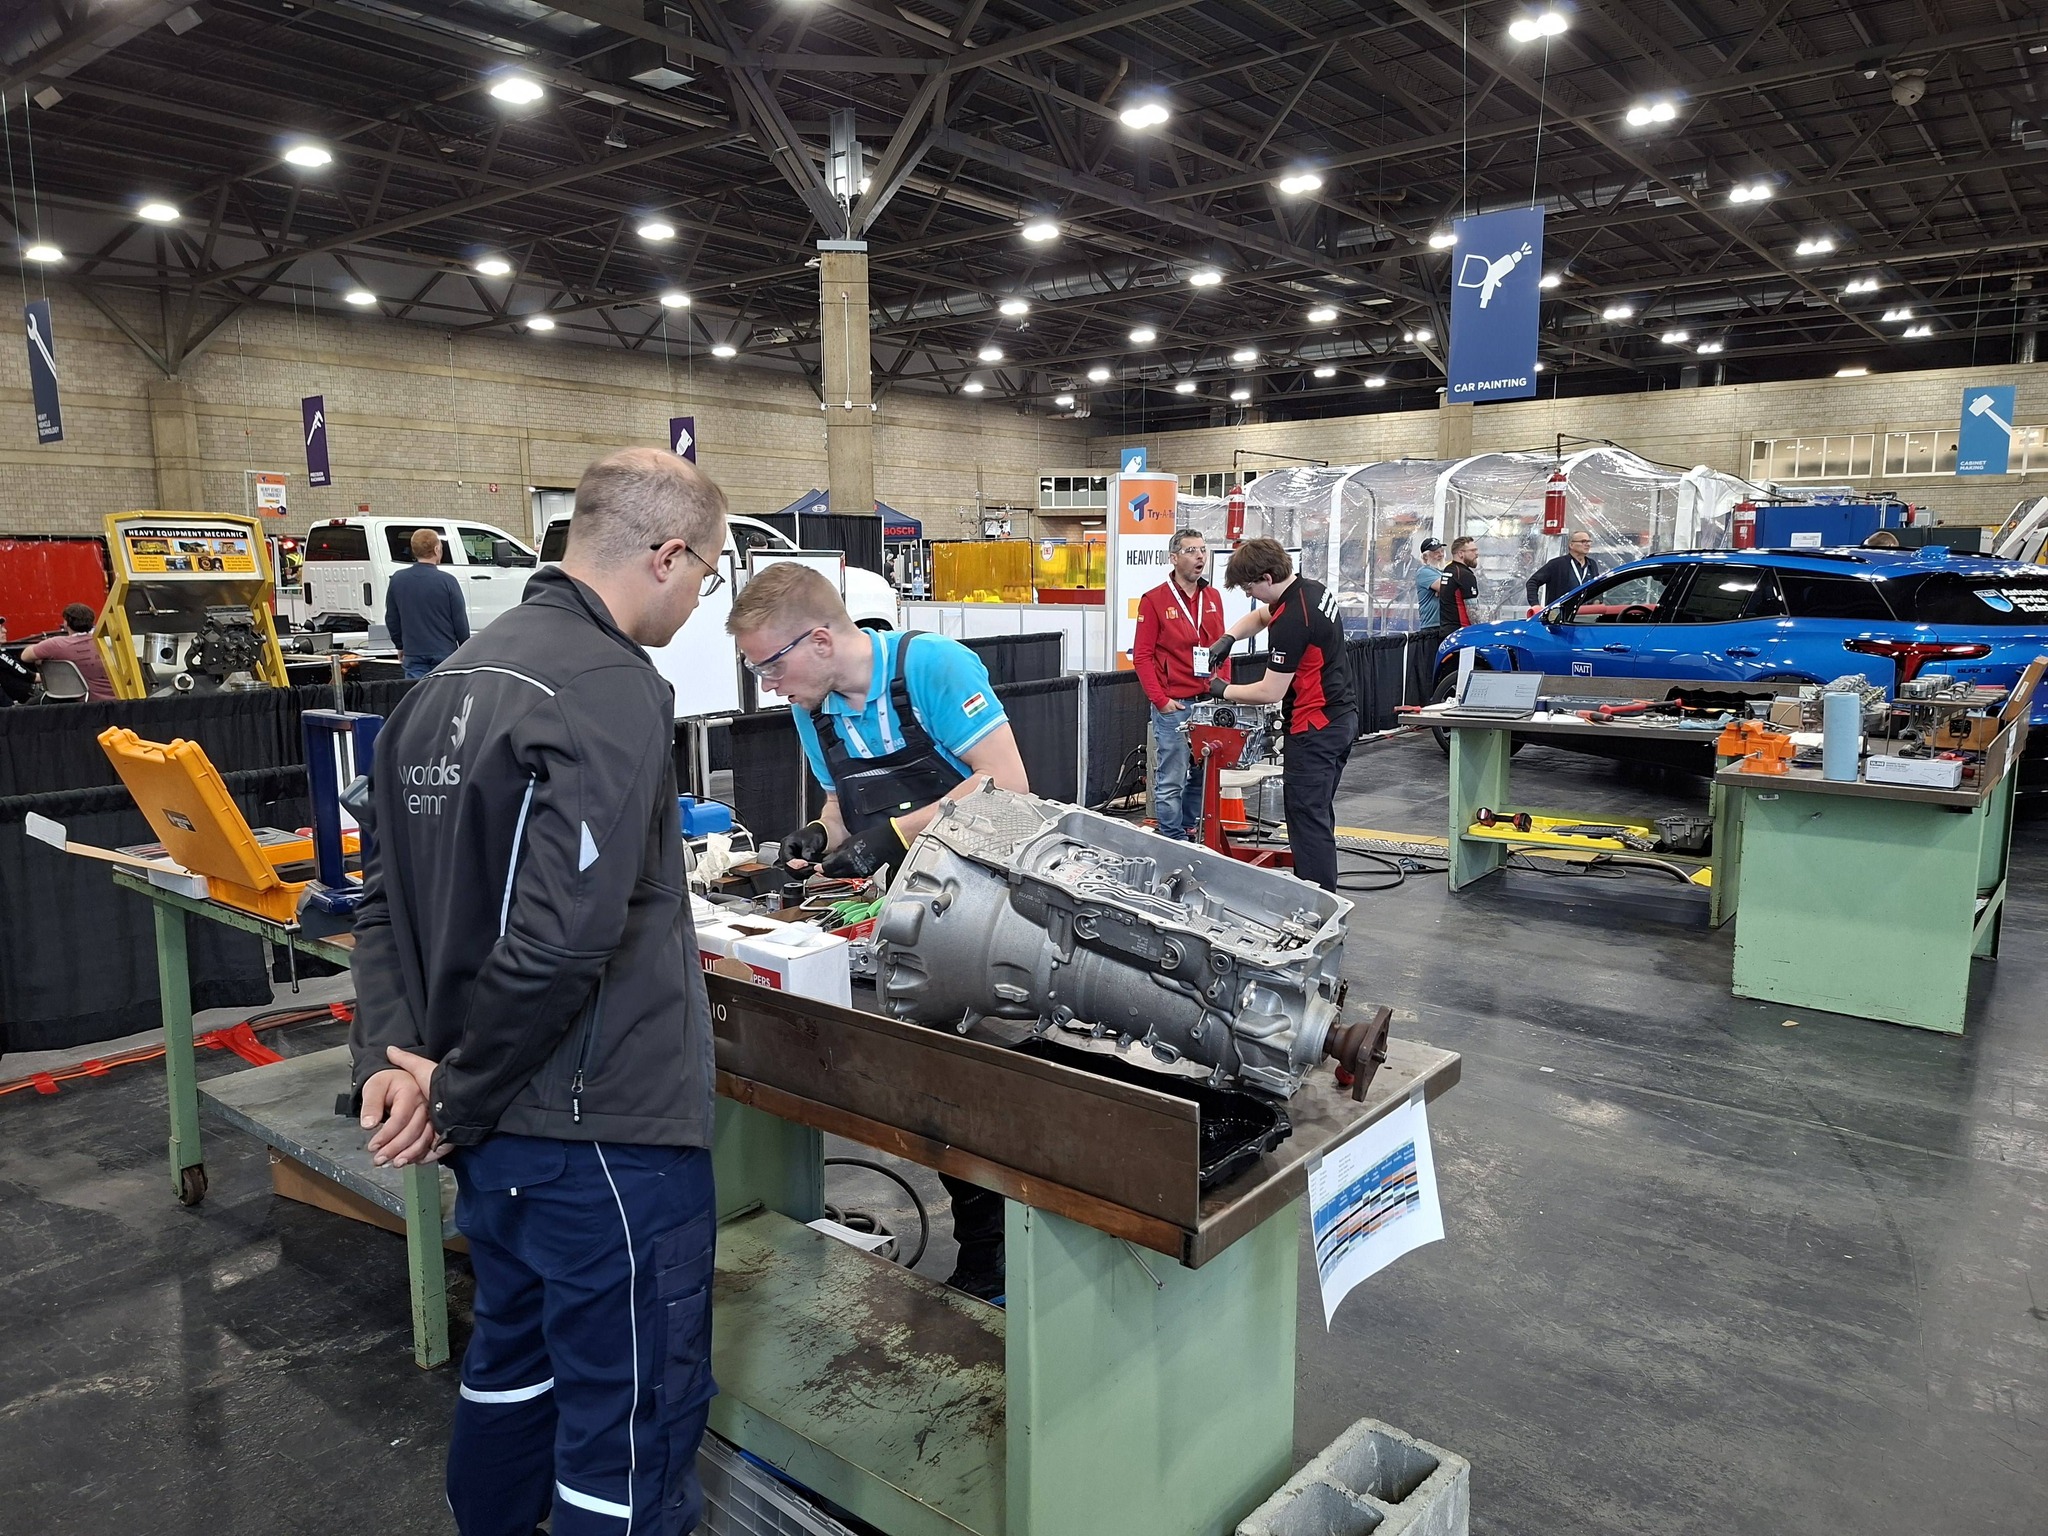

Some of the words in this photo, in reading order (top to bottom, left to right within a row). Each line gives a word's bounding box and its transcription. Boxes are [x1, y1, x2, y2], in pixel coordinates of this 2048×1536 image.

[1454, 383, 1475, 393] CAR
[1478, 378, 1527, 391] PAINTING
[128, 529, 154, 537] HEAVY
[156, 530, 202, 538] EQUIPMENT
[884, 526, 915, 535] BOSCH
[1126, 549, 1154, 566] HEAVY
[1574, 664, 1590, 674] NAIT
